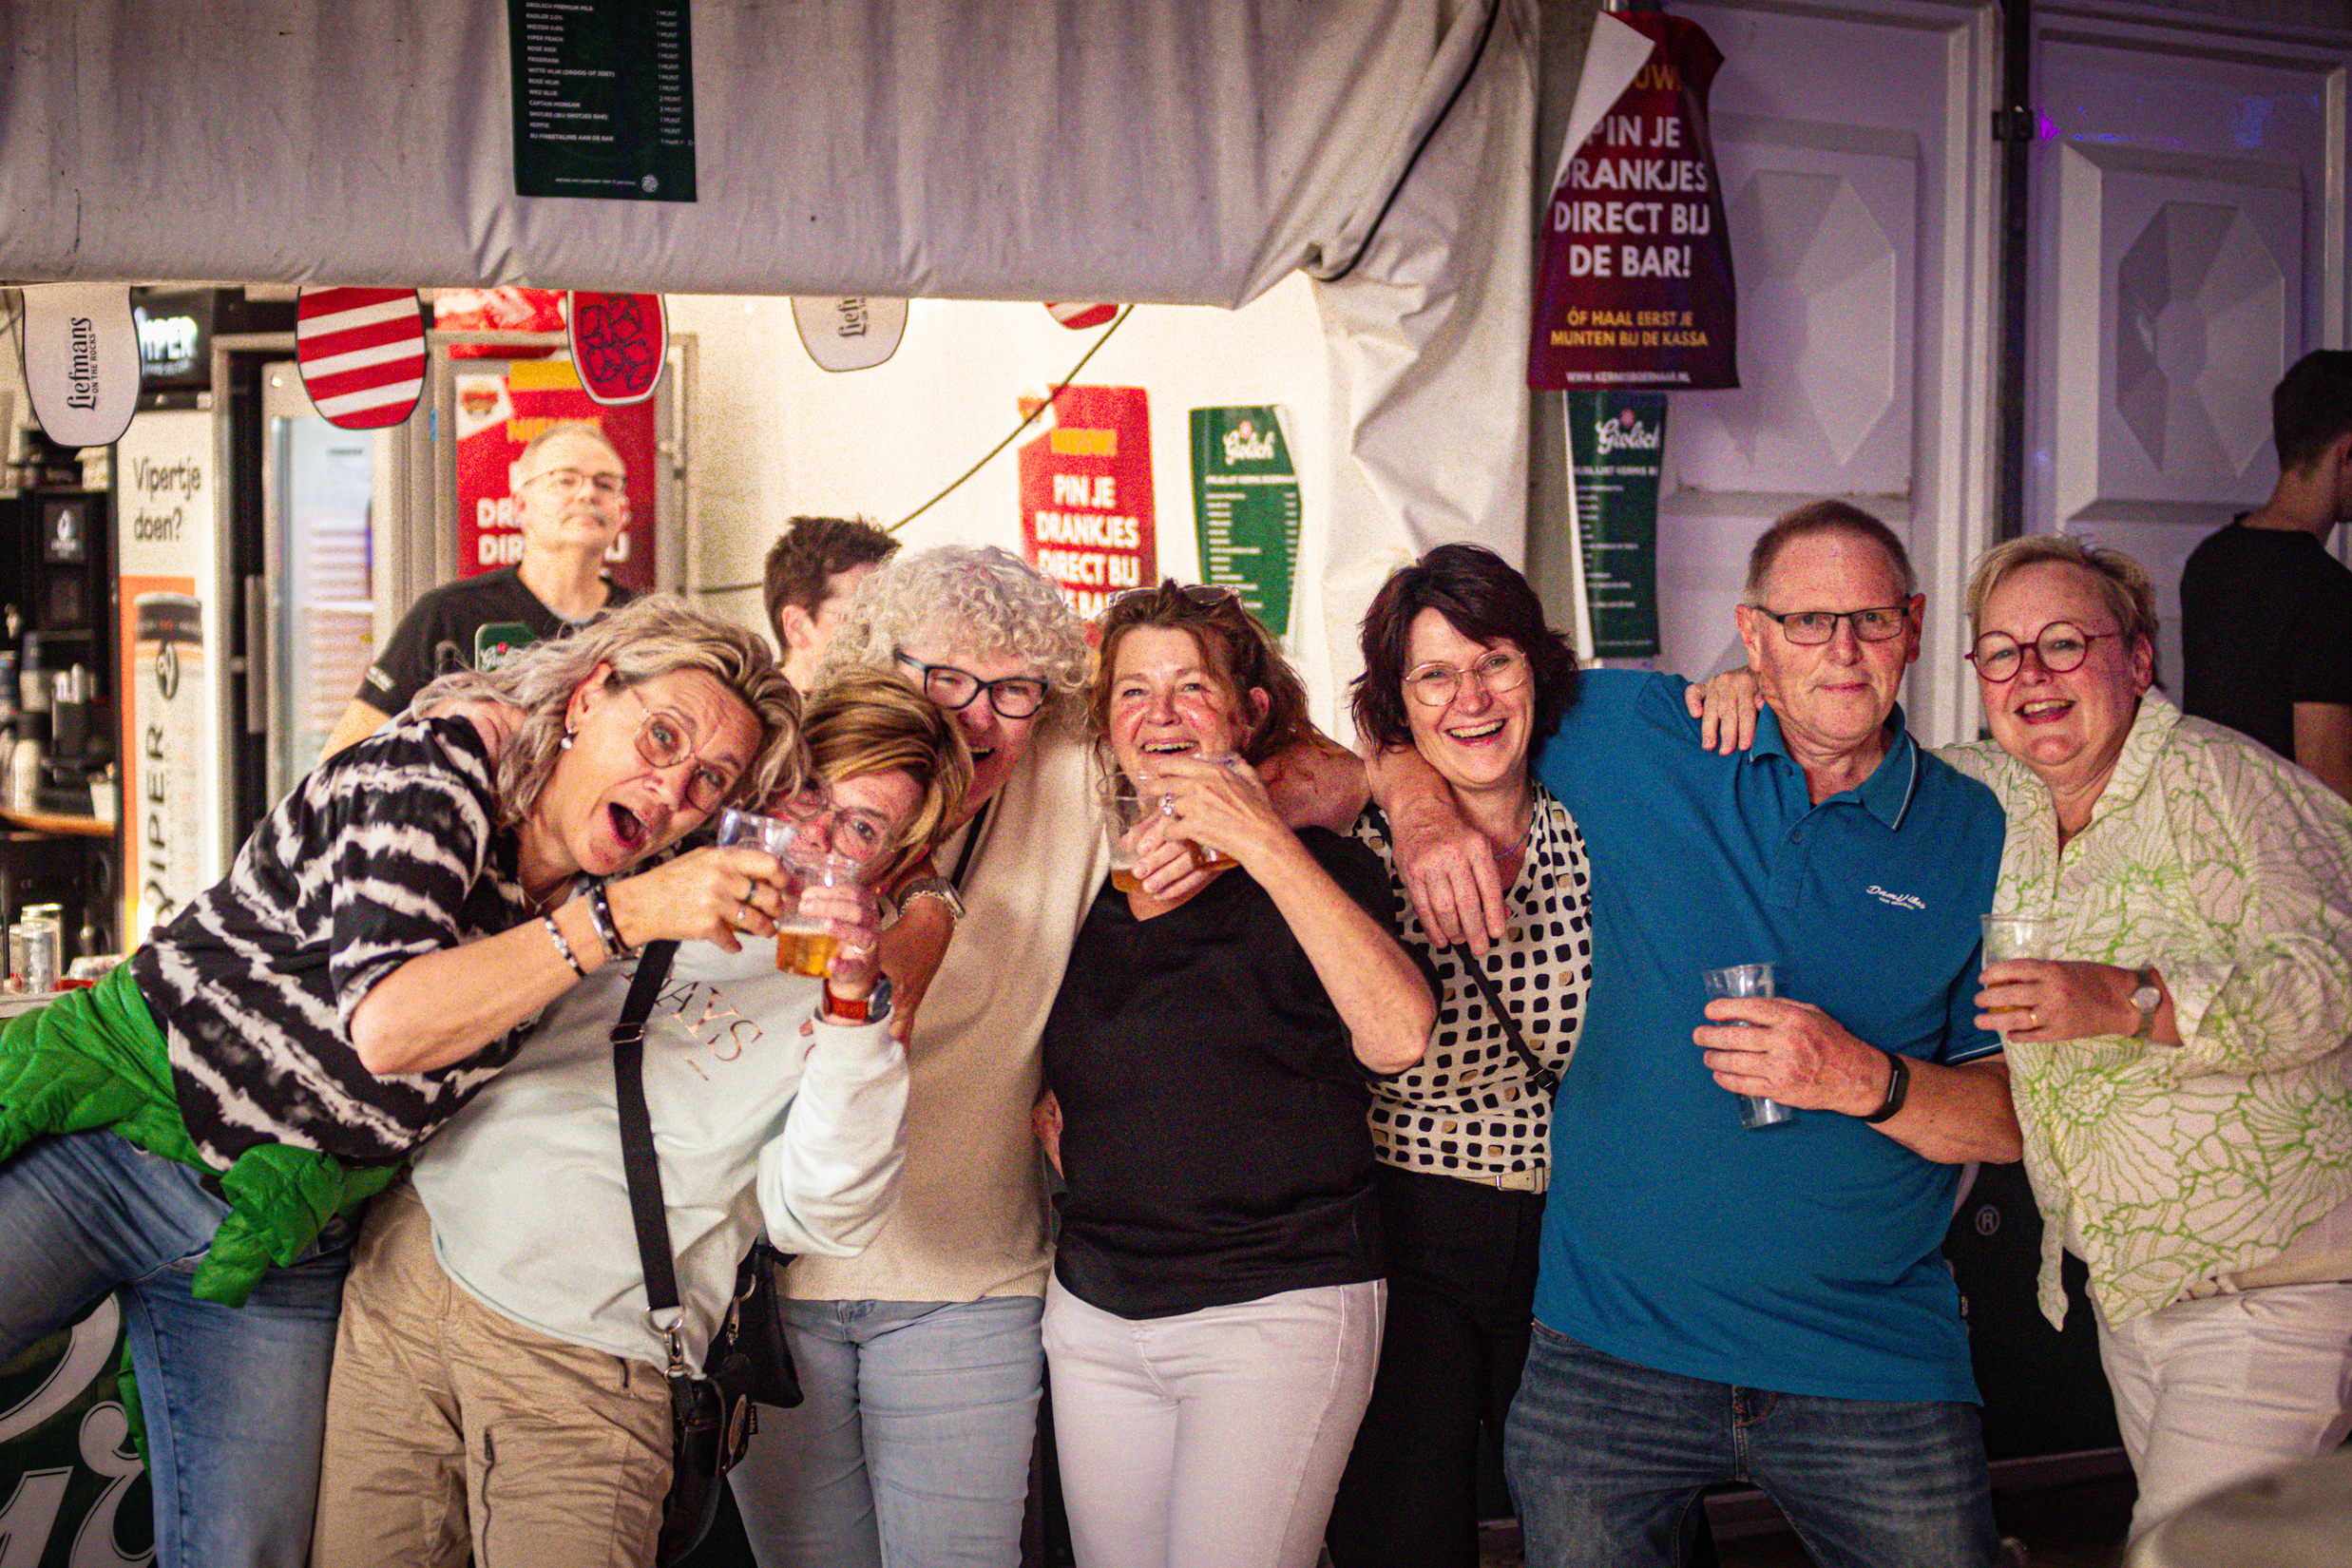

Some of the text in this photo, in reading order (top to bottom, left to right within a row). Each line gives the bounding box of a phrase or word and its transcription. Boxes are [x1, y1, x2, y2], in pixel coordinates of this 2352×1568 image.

[1649, 116, 1681, 147] JE
[1554, 201, 1711, 236] DIRECT BIJ
[1570, 244, 1692, 278] DE BAR!
[1591, 310, 1633, 327] HAAL
[1636, 310, 1677, 327] EERST
[1679, 310, 1693, 327] JE
[1550, 330, 1709, 347] MUNTEN BIJ DE KASSA
[67, 317, 97, 411] Liefmans
[91, 381, 99, 393] ON
[133, 456, 201, 501] Vipertje
[1053, 474, 1117, 508] PIN JE
[134, 507, 182, 542] doen?
[1035, 510, 1140, 549] DRANKJES
[1039, 549, 1140, 587] DIRECT BIJ
